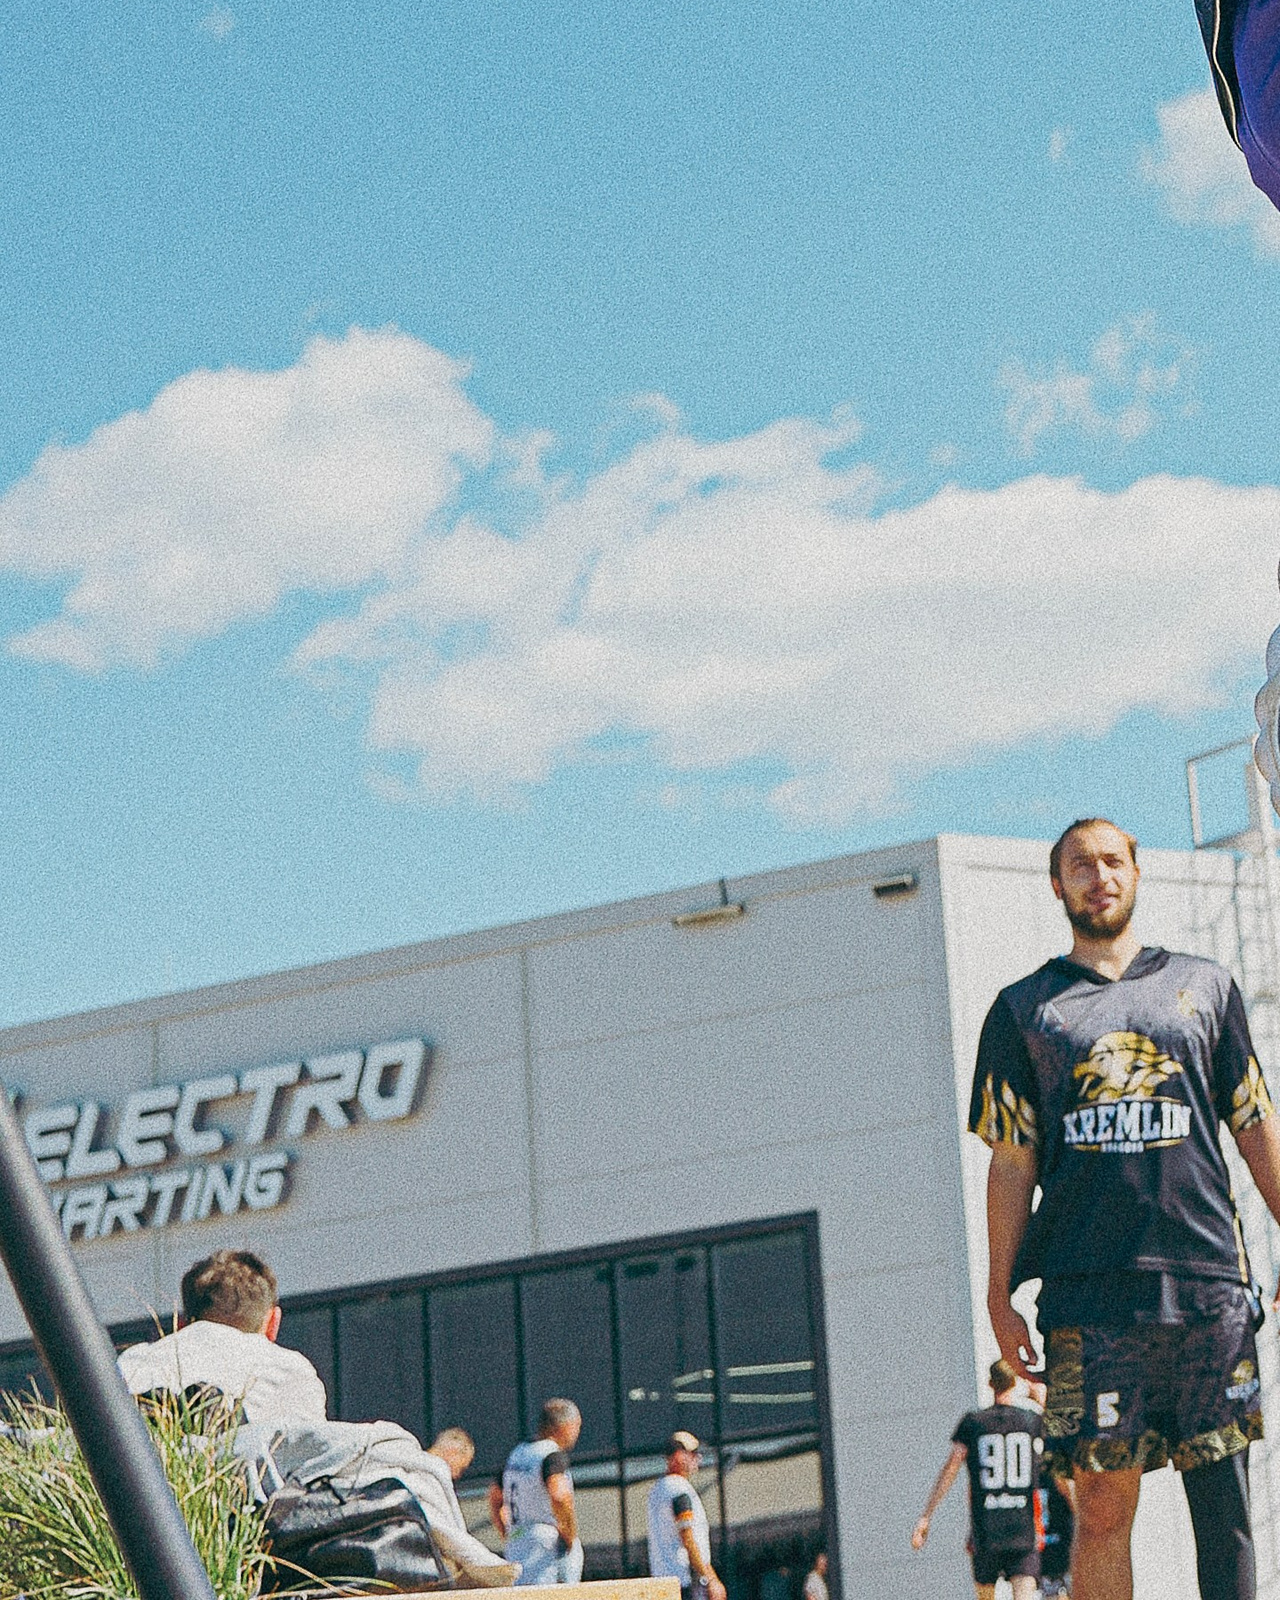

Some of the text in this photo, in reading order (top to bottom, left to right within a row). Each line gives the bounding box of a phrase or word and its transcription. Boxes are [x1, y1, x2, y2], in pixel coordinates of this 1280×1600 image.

[24, 1037, 427, 1183] ELECTRO
[1063, 1101, 1193, 1144] KREMLIN
[52, 1151, 290, 1242] ARTING
[1096, 1391, 1122, 1428] 5
[978, 1431, 1032, 1489] 90
